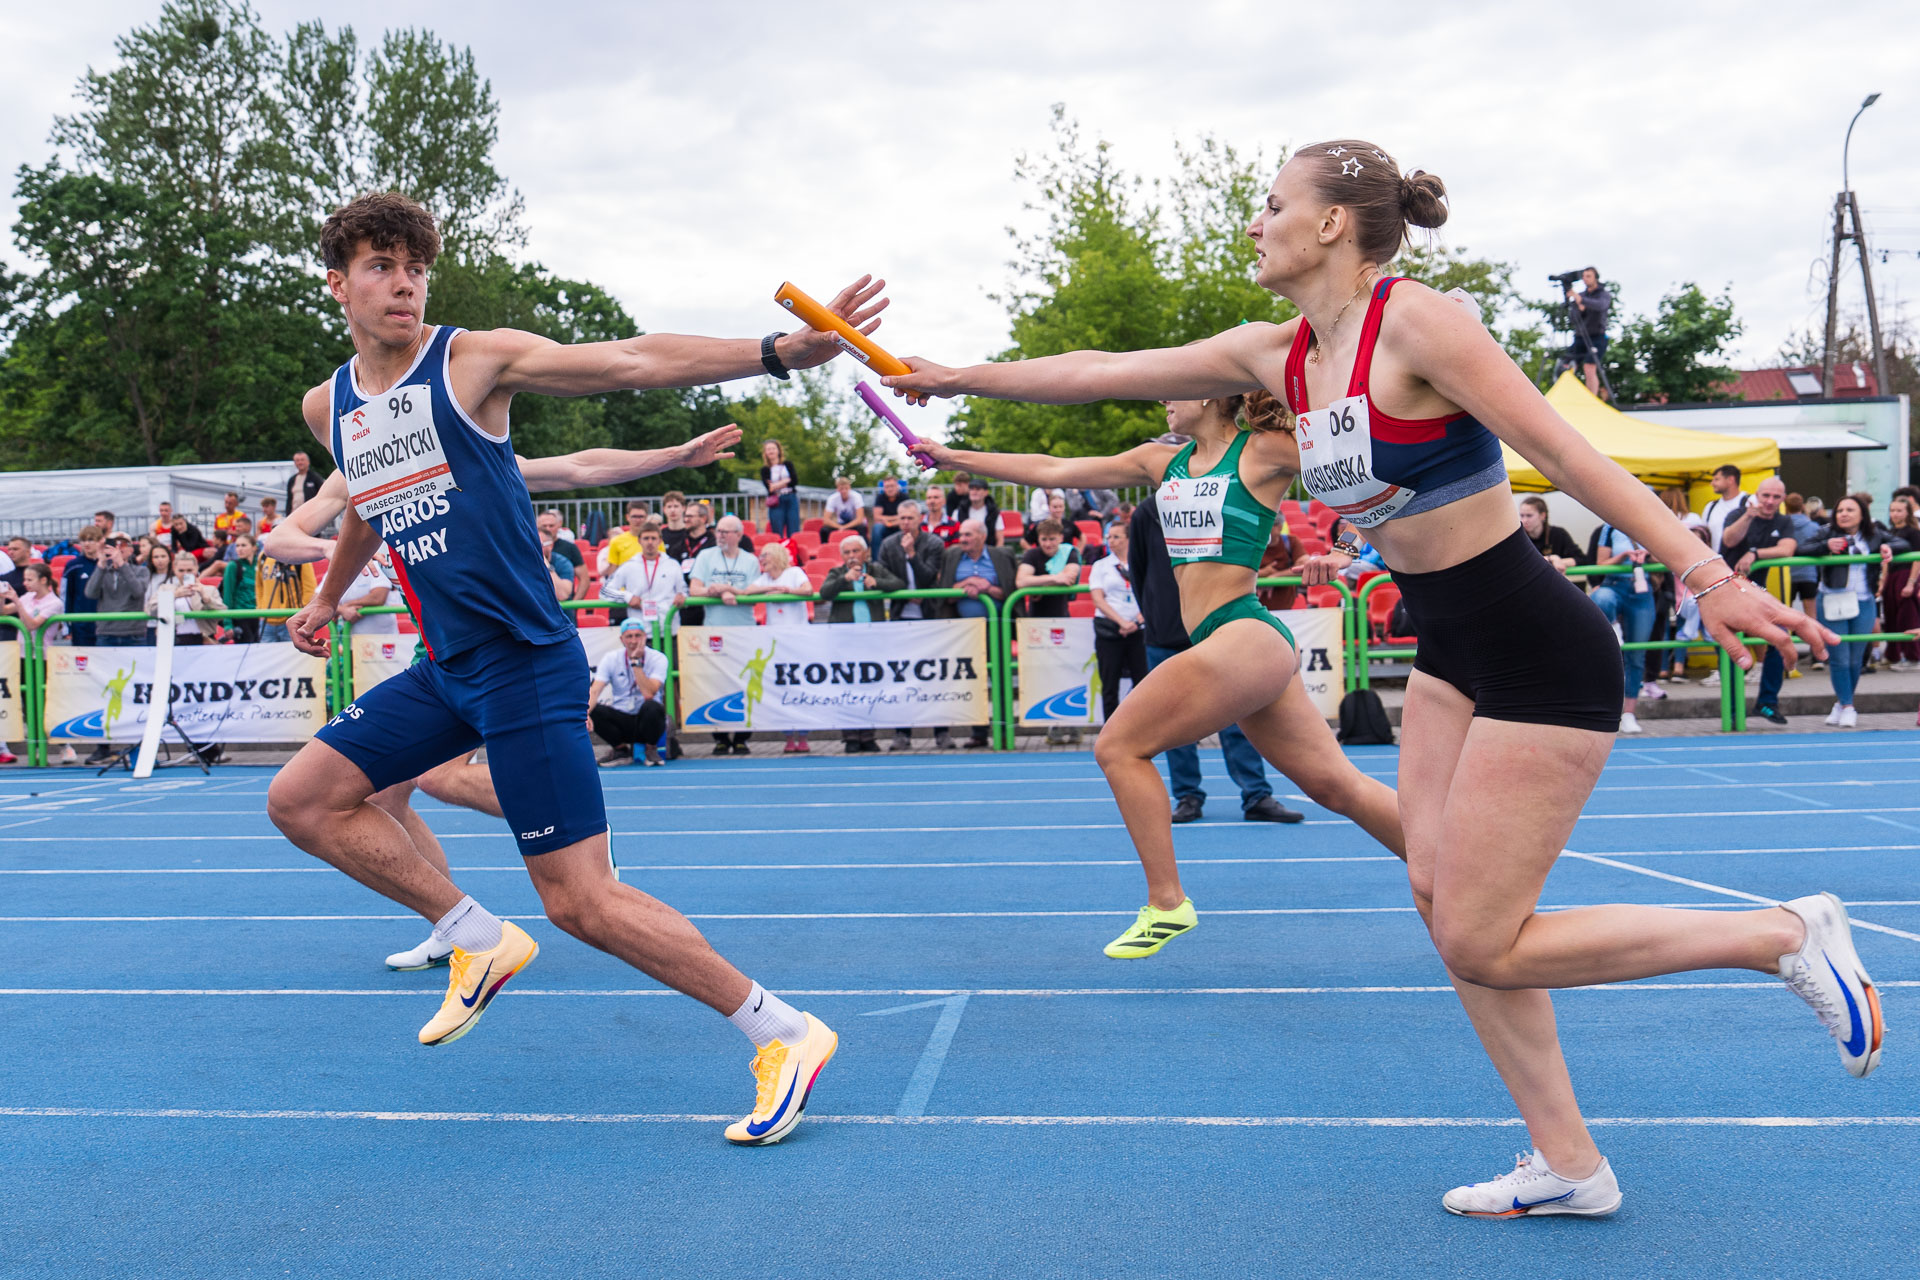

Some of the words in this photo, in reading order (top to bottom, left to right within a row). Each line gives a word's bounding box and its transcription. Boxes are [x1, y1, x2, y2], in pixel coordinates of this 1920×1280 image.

[840, 342, 866, 360] polanik
[388, 392, 412, 419] 96
[352, 426, 370, 442] ORLEN
[1330, 406, 1355, 436] 06
[347, 427, 436, 481] KIERNOŻYCKI
[1302, 454, 1370, 494] WASILEWSKA
[366, 491, 412, 513] PIASECZNO
[414, 482, 436, 497] 2026
[1194, 482, 1218, 497] 128
[382, 491, 450, 538] AGROS
[1162, 510, 1216, 528] MATEJA
[1370, 504, 1396, 520] 2026
[395, 528, 448, 566] ŻARY
[774, 657, 977, 685] KONDYCJA
[251, 704, 312, 720] Piaseczno
[782, 688, 898, 714] Lekkoatletyka
[906, 687, 973, 702] Piaseczno
[522, 826, 554, 840] COLO
